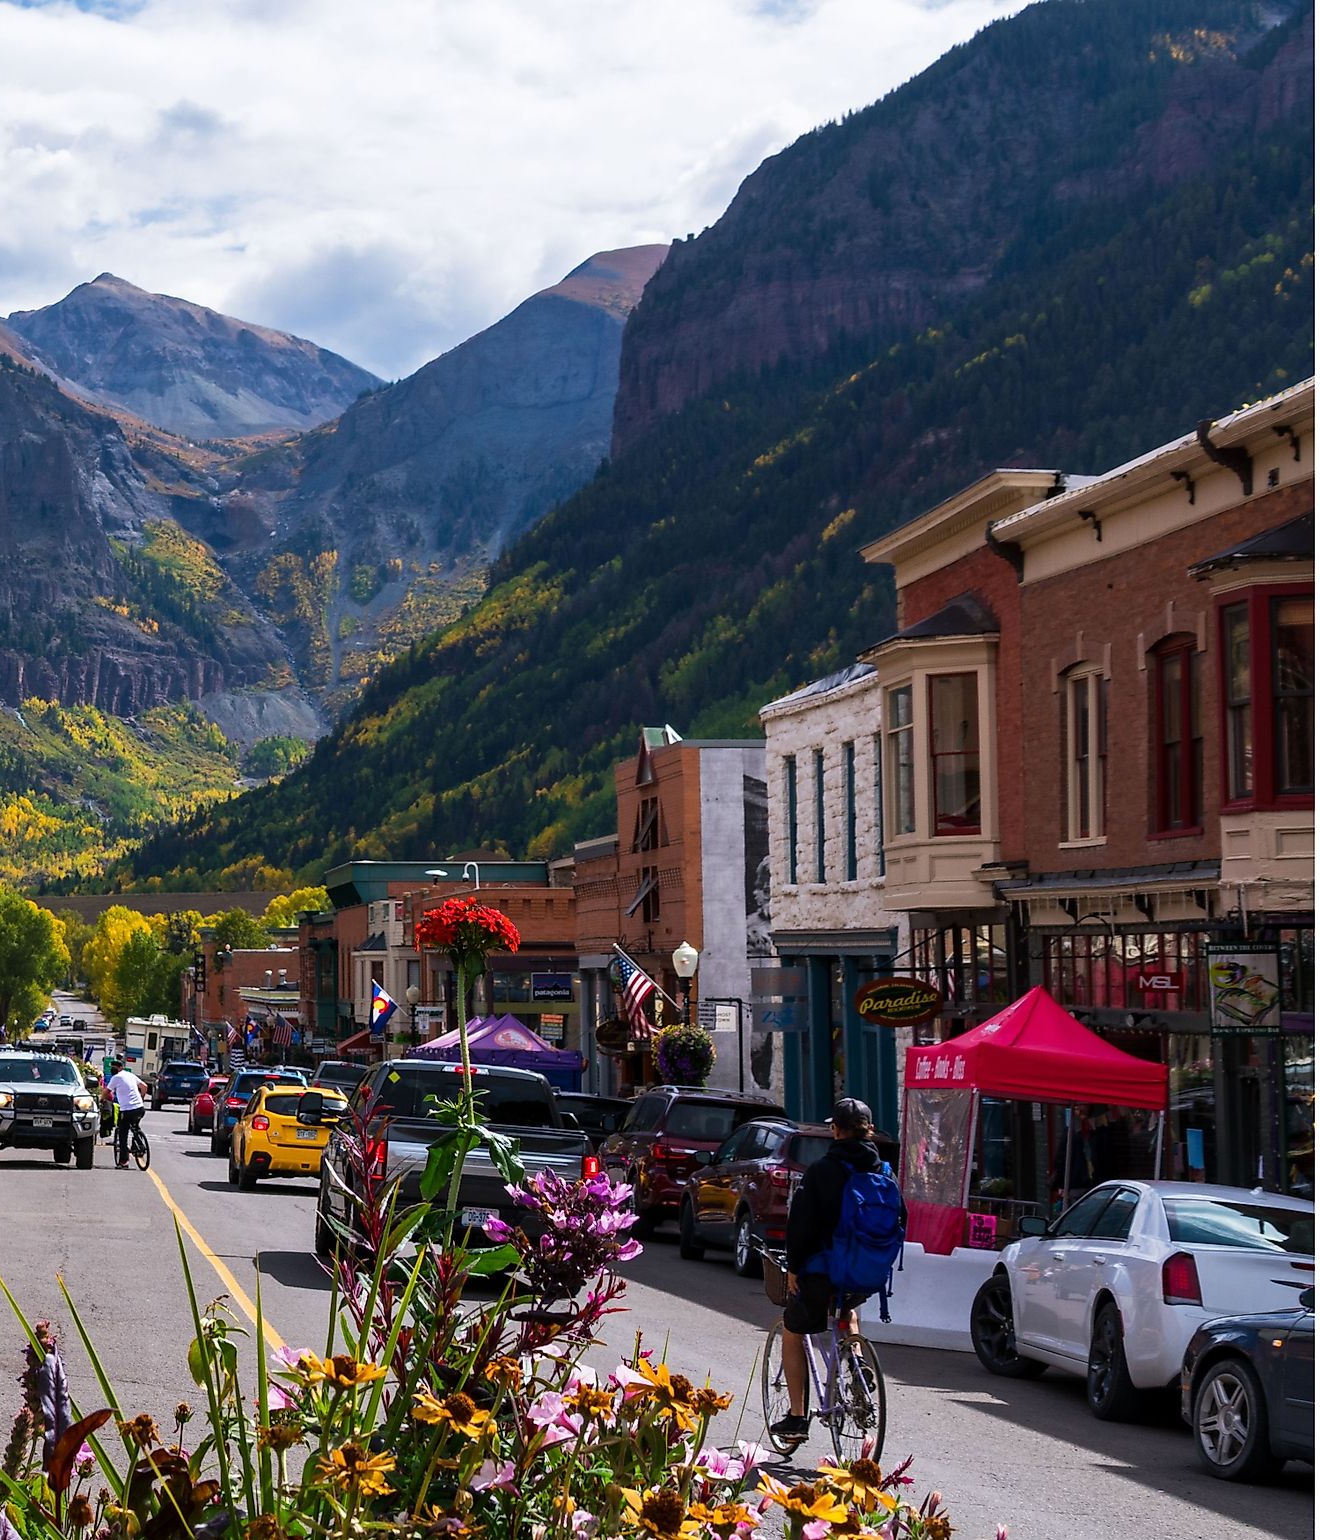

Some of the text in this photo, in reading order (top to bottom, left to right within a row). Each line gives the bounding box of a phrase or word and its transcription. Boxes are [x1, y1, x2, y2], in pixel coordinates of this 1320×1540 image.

[1139, 975, 1180, 989] MSL
[534, 989, 570, 997] patagonia
[859, 990, 938, 1015] Paradise
